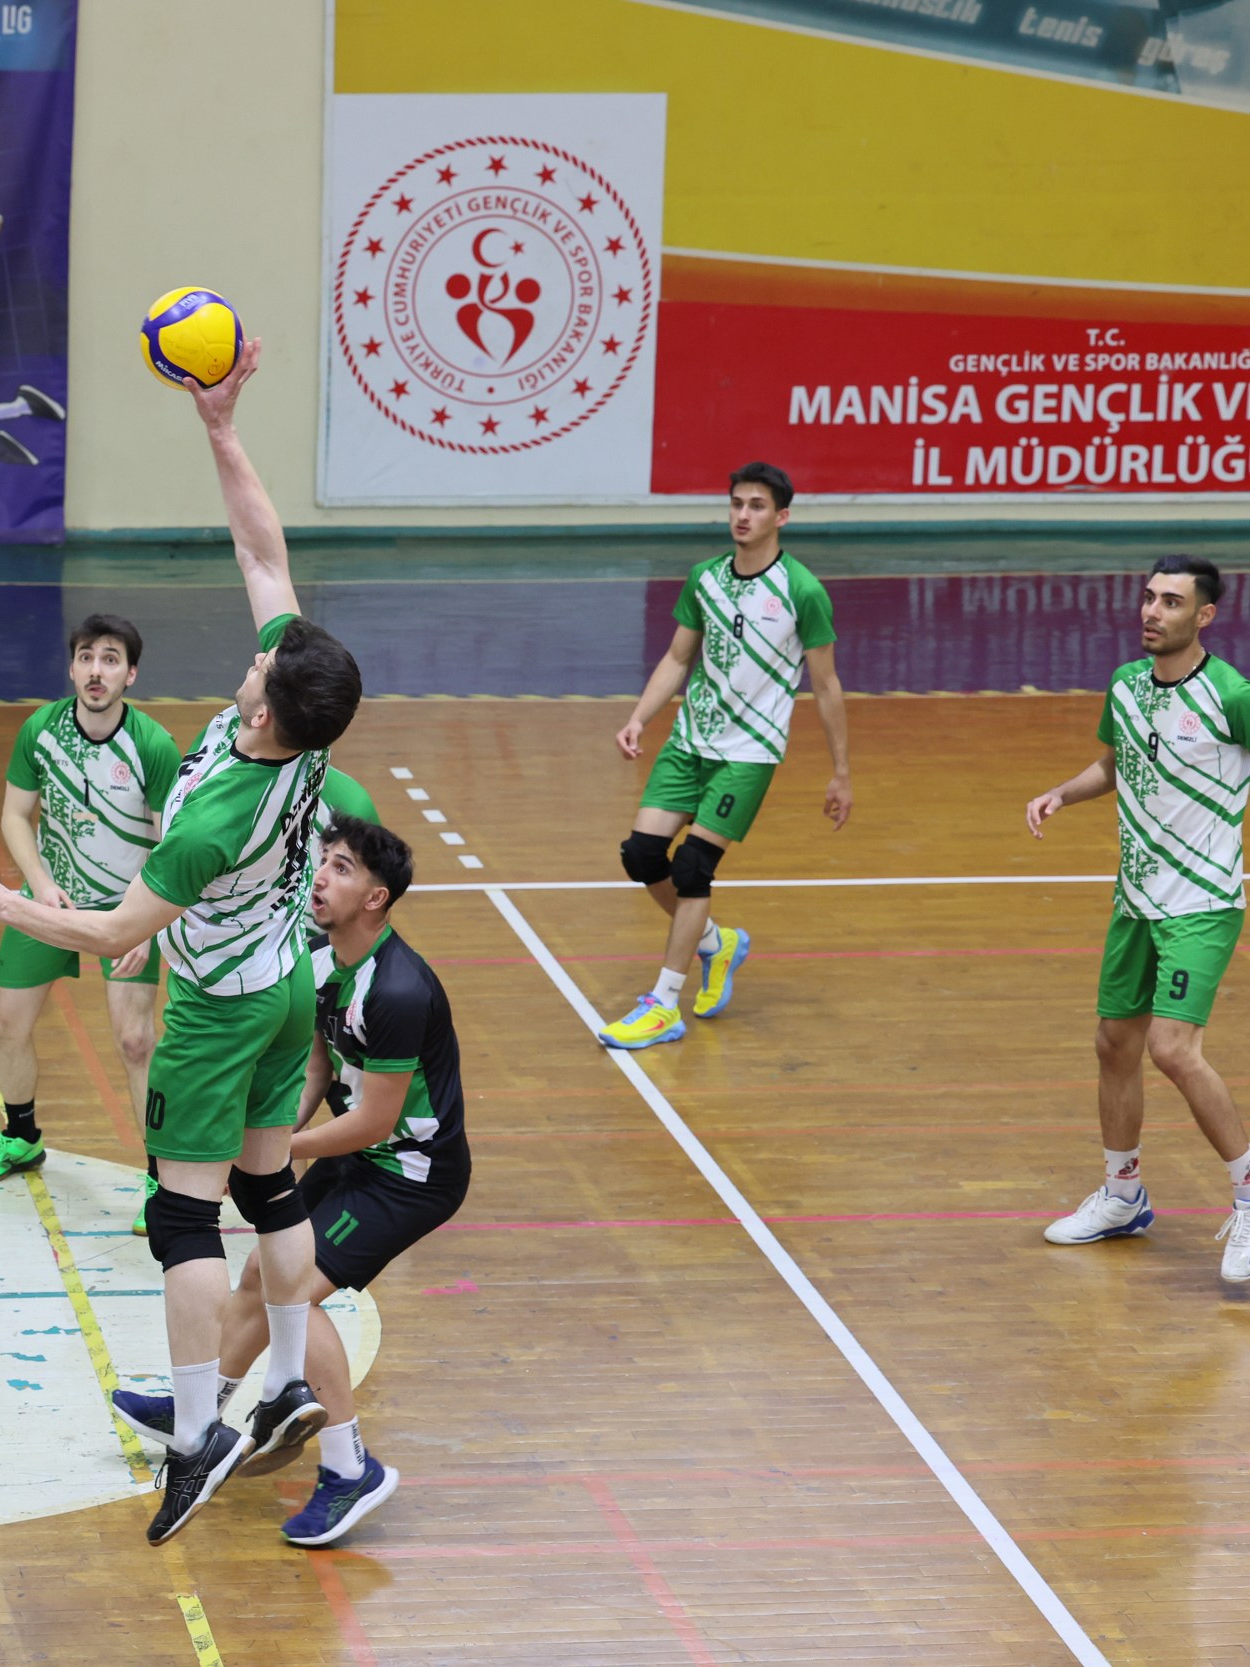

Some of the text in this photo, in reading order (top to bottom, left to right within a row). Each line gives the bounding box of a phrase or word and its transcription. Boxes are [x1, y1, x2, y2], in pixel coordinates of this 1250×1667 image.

[1018, 6, 1103, 48] tenis
[393, 195, 593, 393] TÜRKİYE CUMHURİYETİ GENÇLİK VE SPOR BAKANLIĞI
[1086, 328, 1125, 347] T.C.
[949, 350, 1046, 377] GENÇLİK
[1052, 354, 1080, 372] VE
[1084, 353, 1140, 371] SPOR
[788, 373, 1250, 433] MANİSA GENÇLİK V
[912, 435, 1250, 486] İL MÜDÜRLÜĞ
[733, 614, 744, 639] 8
[1147, 732, 1159, 762] 9
[83, 778, 90, 807] 1
[716, 793, 735, 818] 8
[1169, 970, 1189, 1000] 9
[145, 1087, 166, 1130] 10
[324, 1209, 359, 1246] 11
